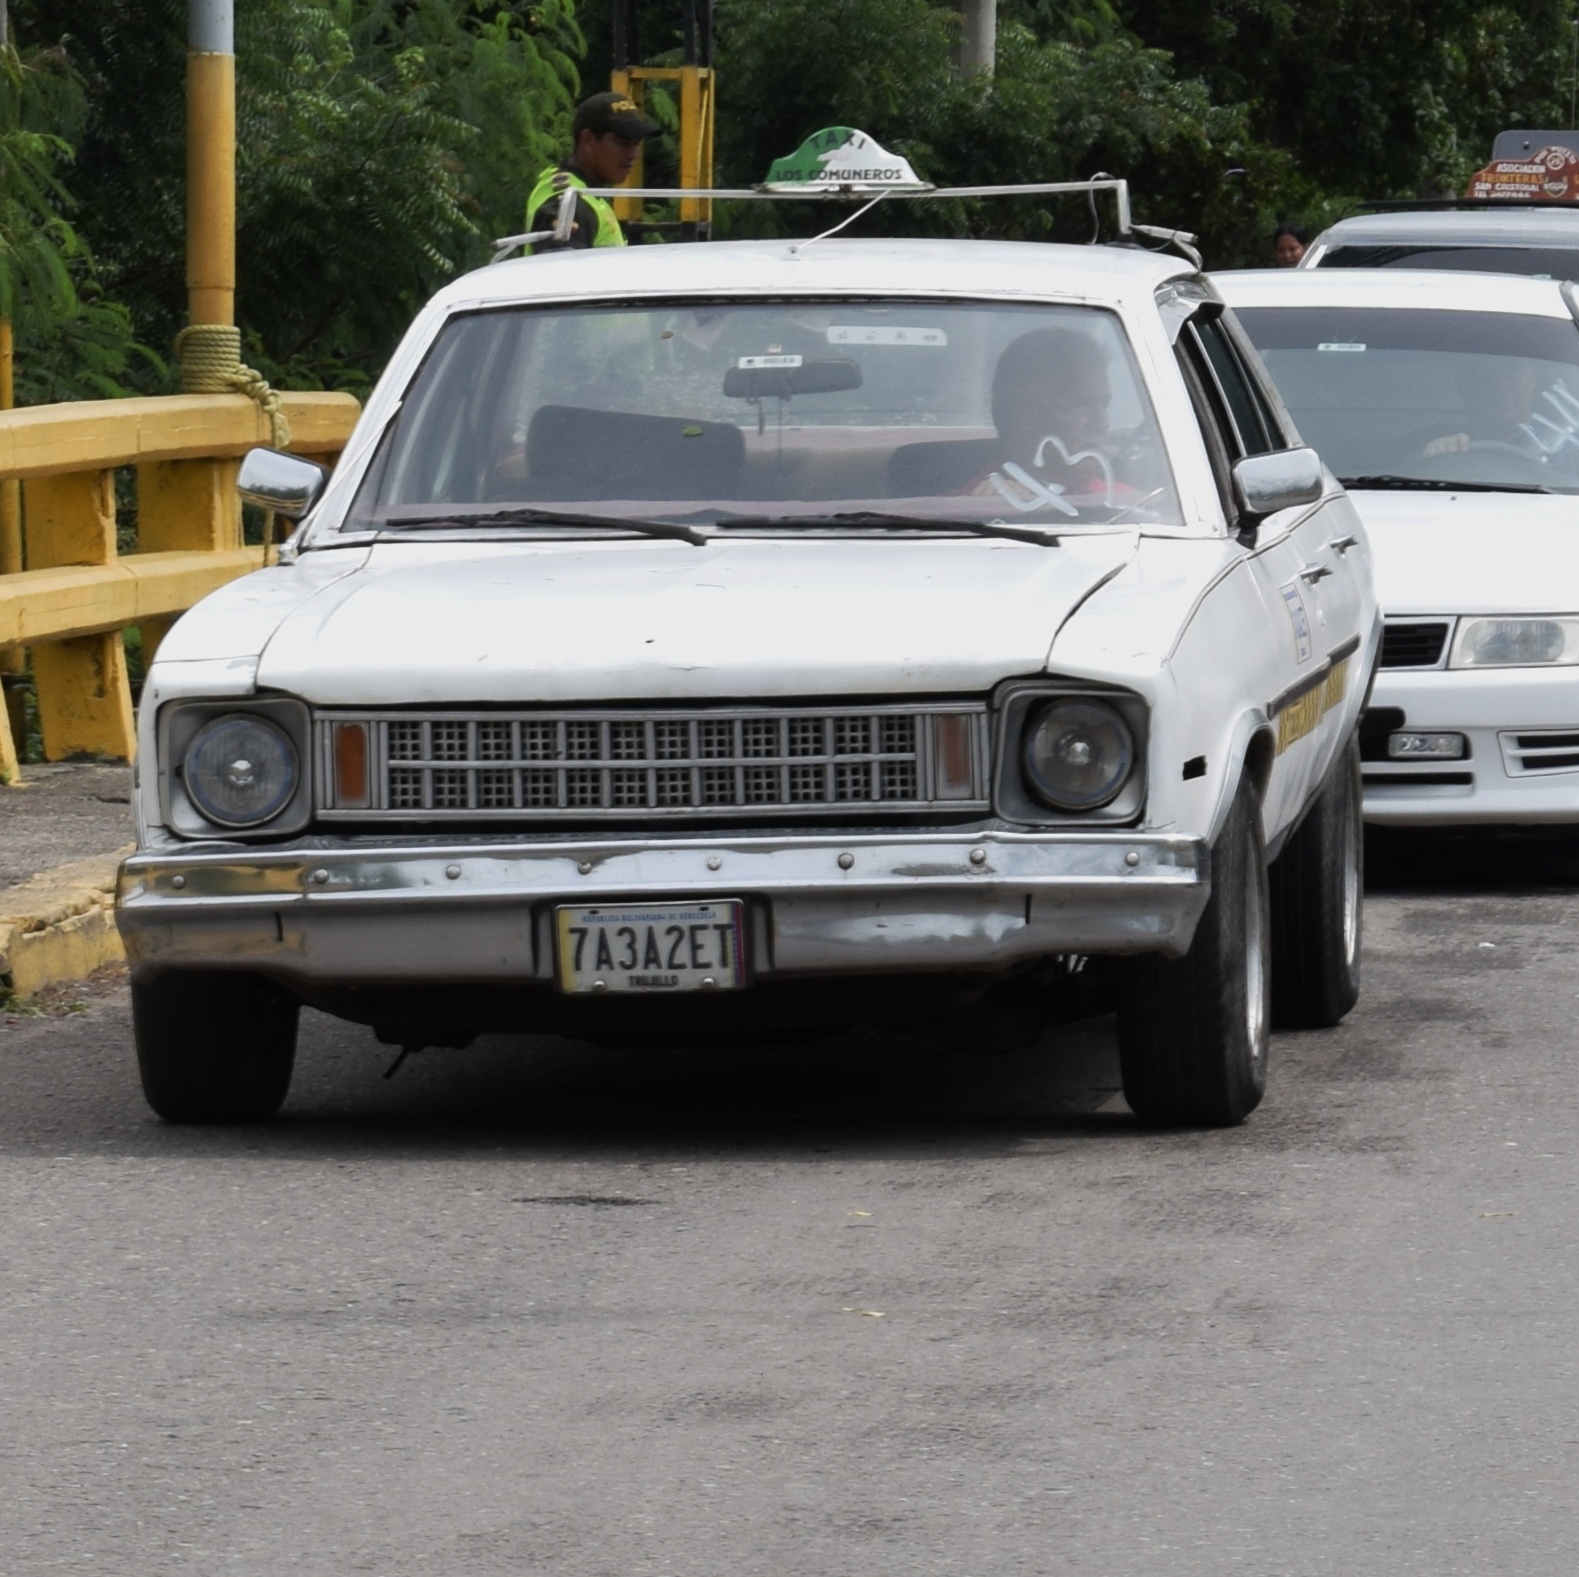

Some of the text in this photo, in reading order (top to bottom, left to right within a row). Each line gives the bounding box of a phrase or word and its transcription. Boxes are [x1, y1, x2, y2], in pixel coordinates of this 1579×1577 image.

[809, 130, 866, 150] TAXI
[777, 168, 903, 181] LOS COMUNEROS
[1482, 173, 1545, 184] FRONTERAS
[568, 924, 734, 972] 7A3A2ET
